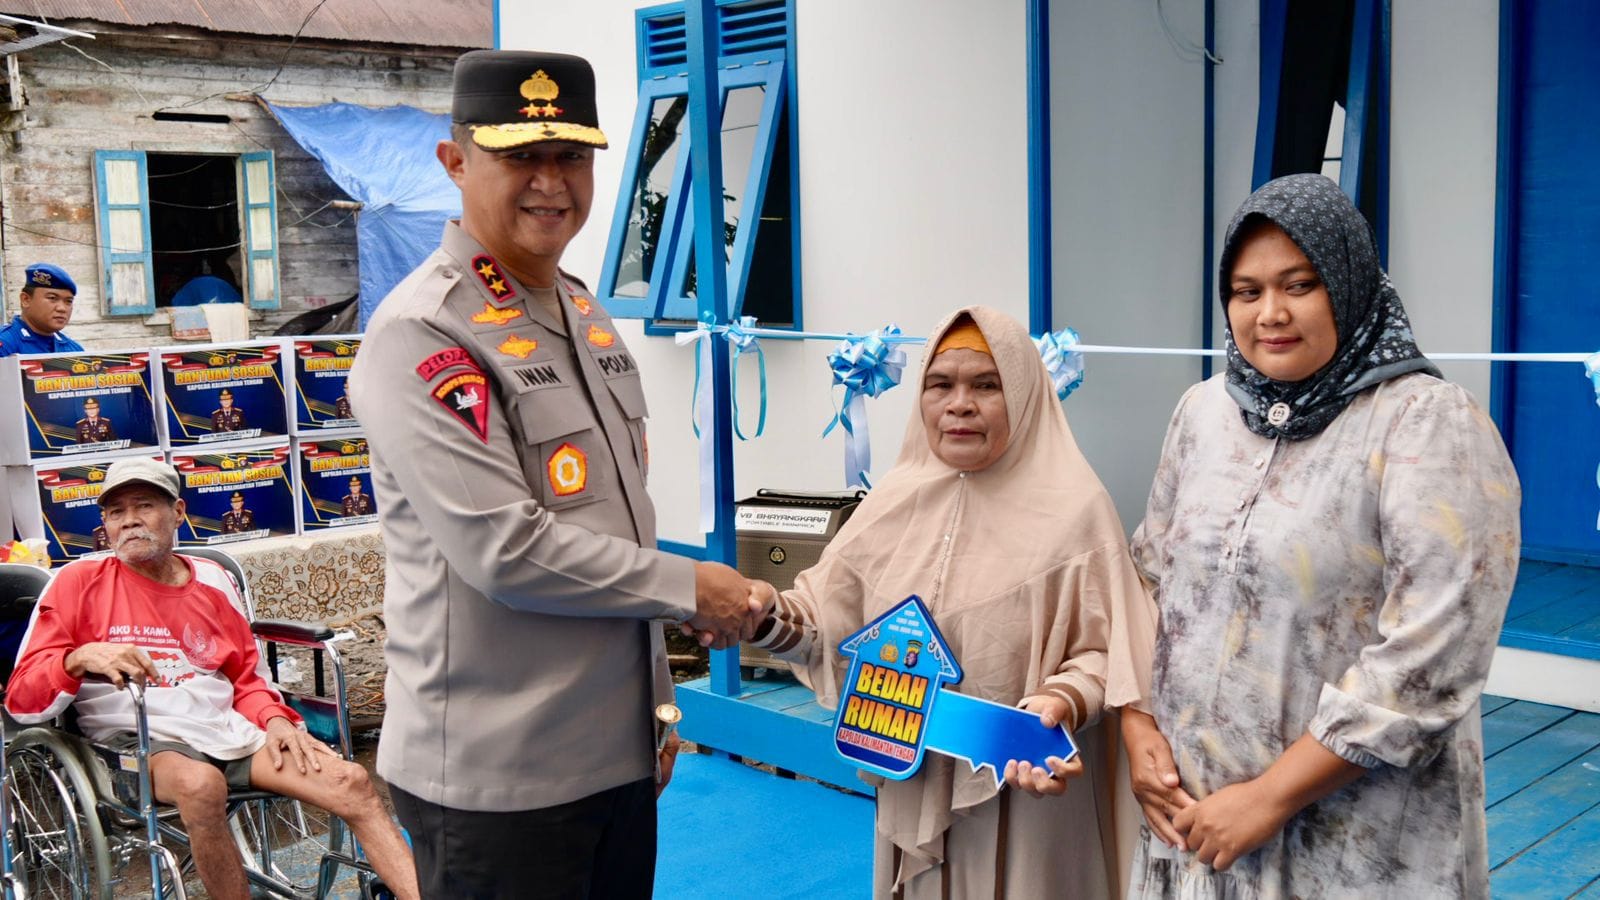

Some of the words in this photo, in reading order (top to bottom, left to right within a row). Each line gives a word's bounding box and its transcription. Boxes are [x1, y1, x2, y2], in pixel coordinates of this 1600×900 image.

[174, 367, 231, 385] BANTUAN
[232, 364, 273, 380] SOSIAL
[598, 354, 635, 376] POLRI
[34, 375, 96, 393] BANTUAN
[97, 372, 142, 388] SOSIAL
[514, 365, 561, 387] IWAN
[310, 455, 360, 472] BANTUAN
[186, 471, 243, 488] BANTUAN
[244, 465, 283, 482] SOSIAL
[51, 483, 104, 503] BANTUA
[756, 512, 826, 523] BHAYANGKARA
[109, 625, 130, 636] AKU
[133, 625, 140, 635] &
[143, 626, 171, 637] KAMU
[855, 661, 928, 709] BEDAH
[843, 694, 923, 745] RUMAH
[837, 727, 861, 745] KAPOLDA
[860, 734, 896, 757] KALIMANTAN
[895, 744, 916, 763] TENGAH
